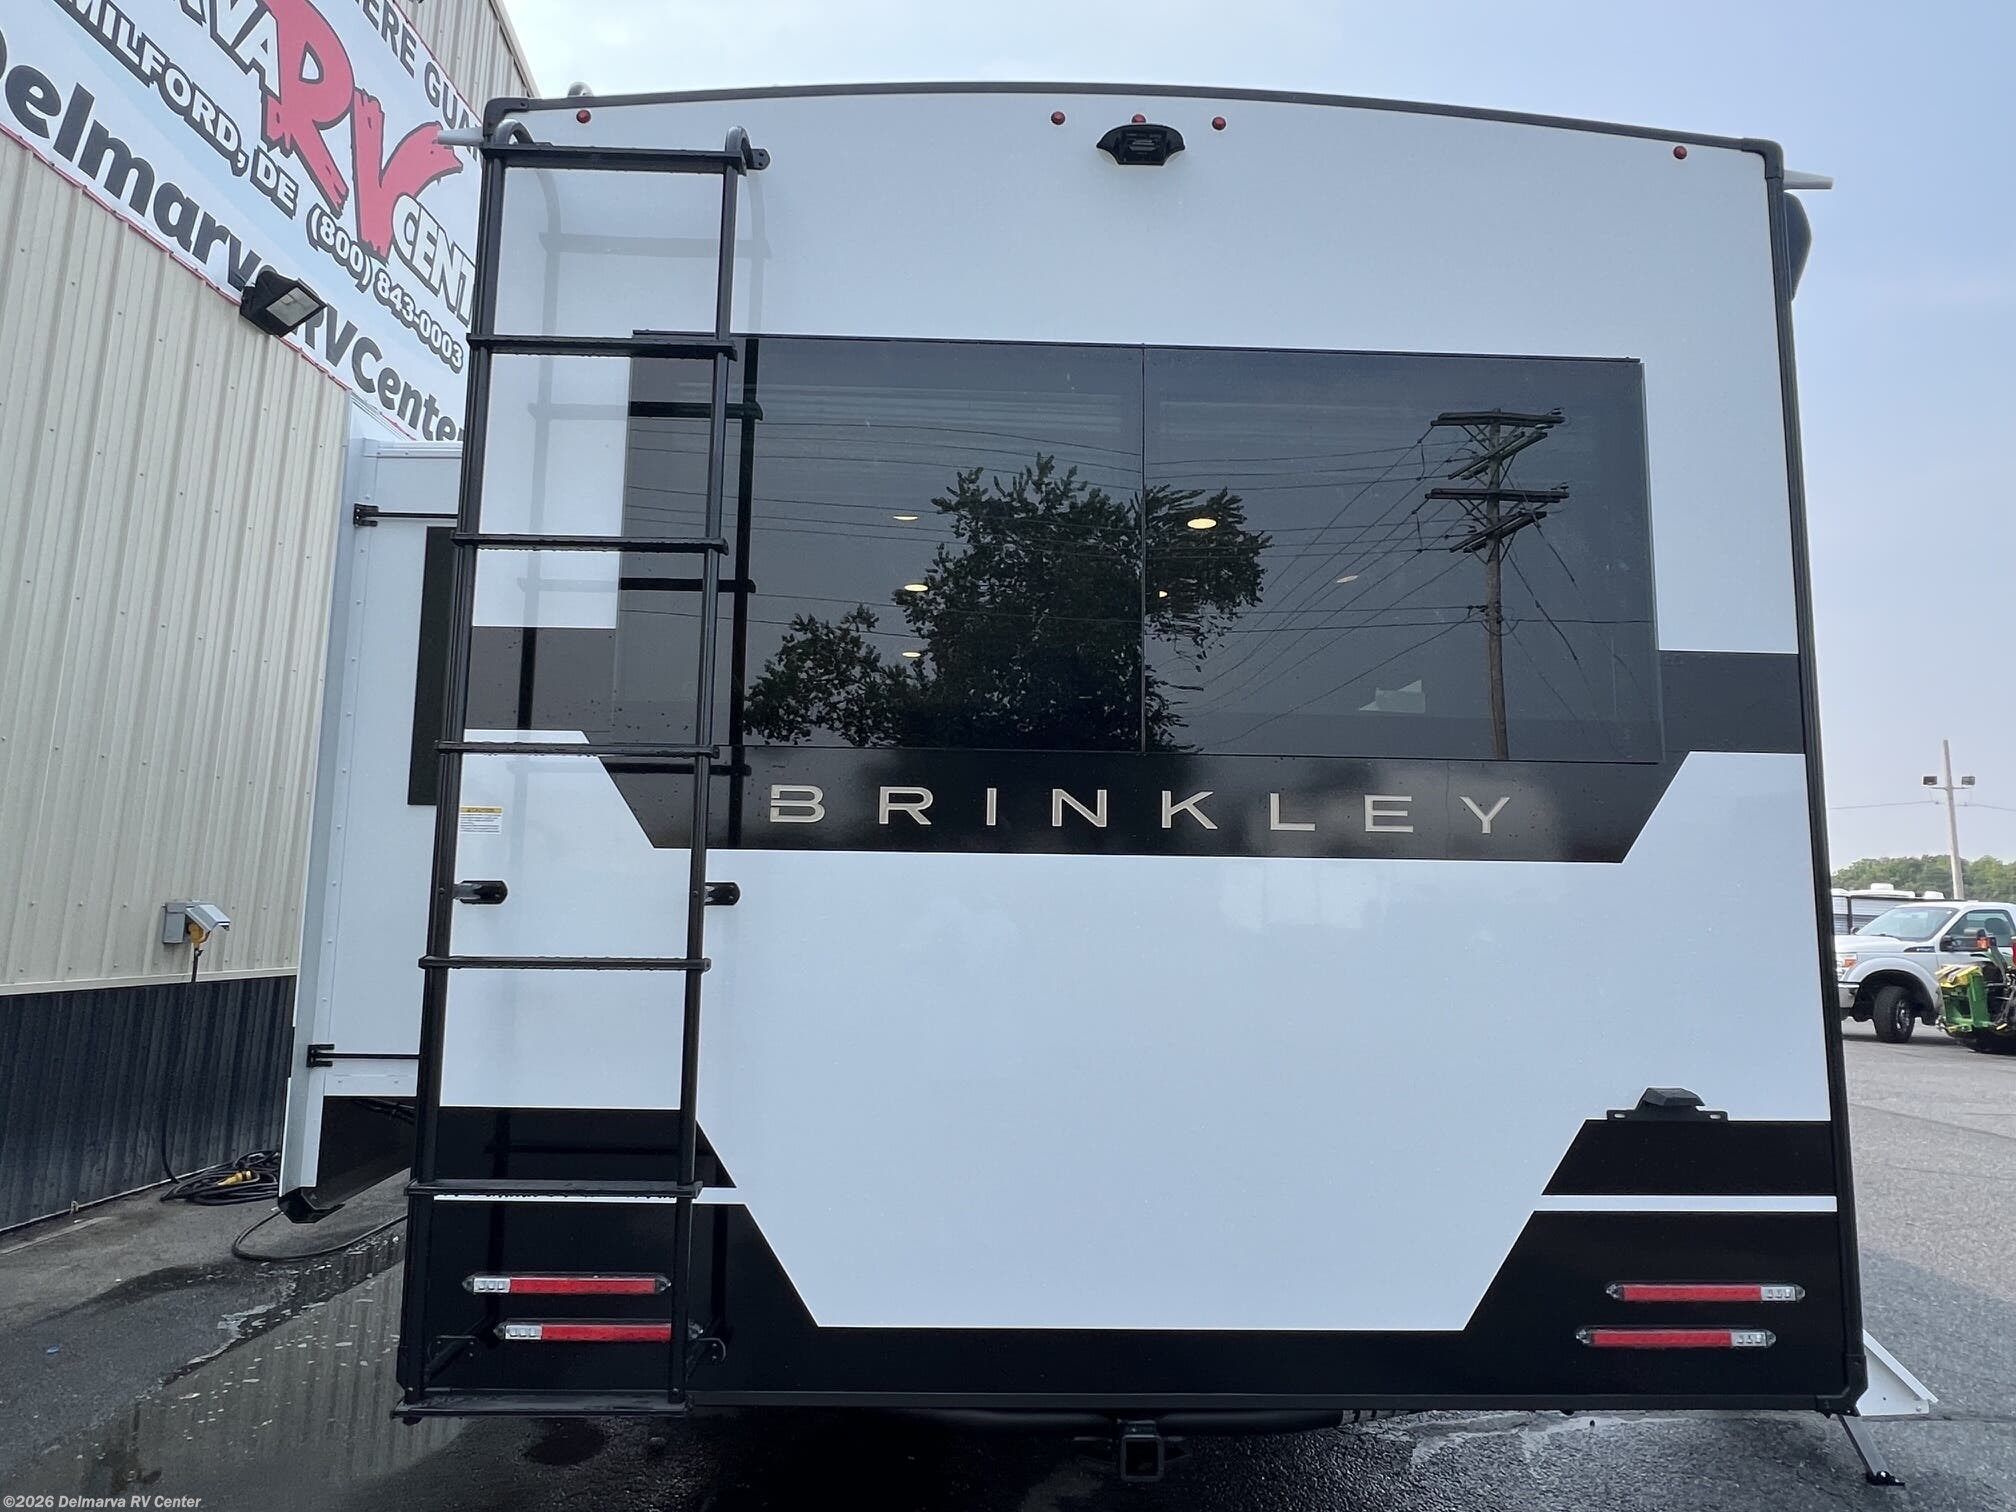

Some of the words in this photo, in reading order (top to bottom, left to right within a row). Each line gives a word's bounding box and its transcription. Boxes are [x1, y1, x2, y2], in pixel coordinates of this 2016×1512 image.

[355, 0, 417, 79] ERE
[180, 0, 281, 104] VA
[261, 0, 463, 266] RV
[250, 145, 299, 219] DE
[306, 203, 373, 293] (800)
[373, 267, 464, 374] 843-0003
[769, 784, 1511, 834] BRINKLEY
